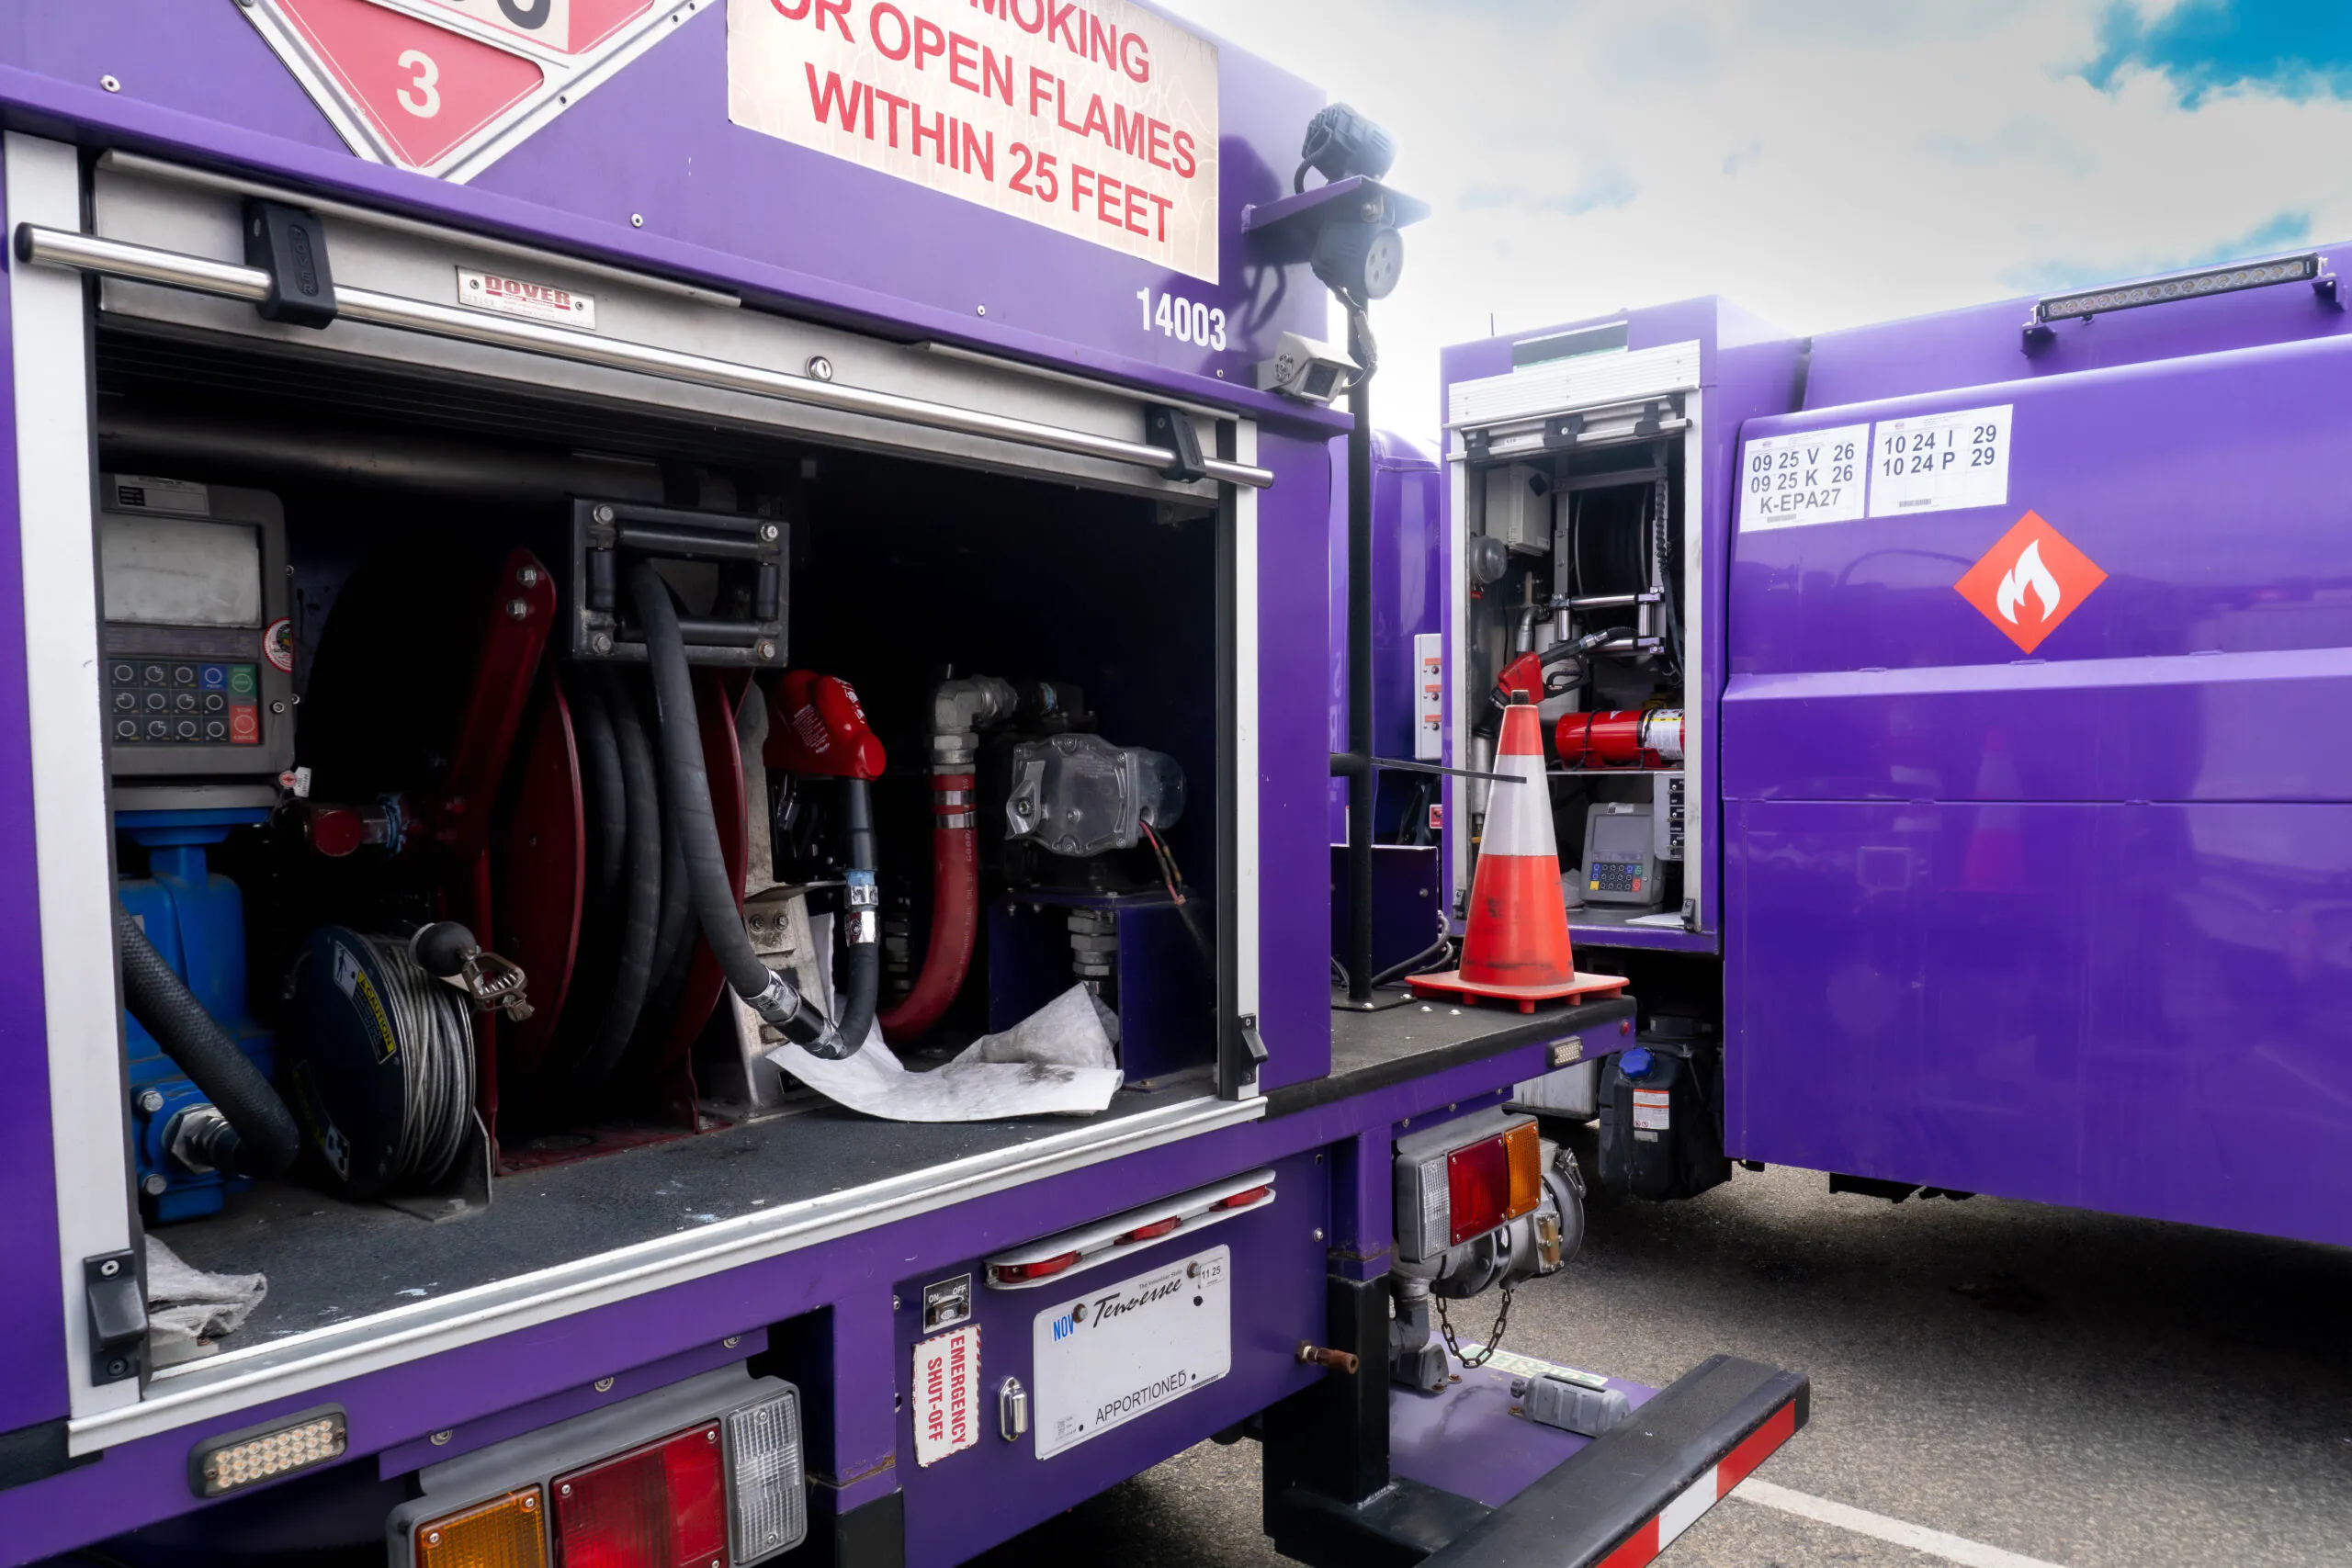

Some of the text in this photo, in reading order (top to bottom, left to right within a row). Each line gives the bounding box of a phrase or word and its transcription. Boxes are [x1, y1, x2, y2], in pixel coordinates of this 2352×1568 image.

[970, 0, 1150, 84] OKING
[397, 50, 441, 118] 3
[869, 2, 1013, 107] OPEN
[1030, 65, 1195, 179] FLAMES
[805, 62, 1173, 243] WITHIN 25 FEET
[485, 276, 571, 306] DOVER
[1136, 288, 1227, 352] 14003
[1752, 443, 1855, 473] 09 25 V 26
[1884, 435, 1906, 456] 10
[1912, 432, 1936, 452] 24
[1973, 424, 1997, 445] 29
[1750, 464, 1854, 494] 09 25 K 26
[1883, 446, 1996, 477] 10 24 P 29
[1759, 488, 1842, 514] K-EPA27
[1201, 1265, 1221, 1280] 11 25
[928, 1284, 967, 1303] ON OFF
[1092, 1278, 1183, 1328] Tennessee
[1053, 1312, 1074, 1342] NOV
[927, 1356, 944, 1442] SHUT-OFF
[950, 1335, 967, 1445] EMERGENCY
[1095, 1370, 1187, 1425] APPORTIONED
